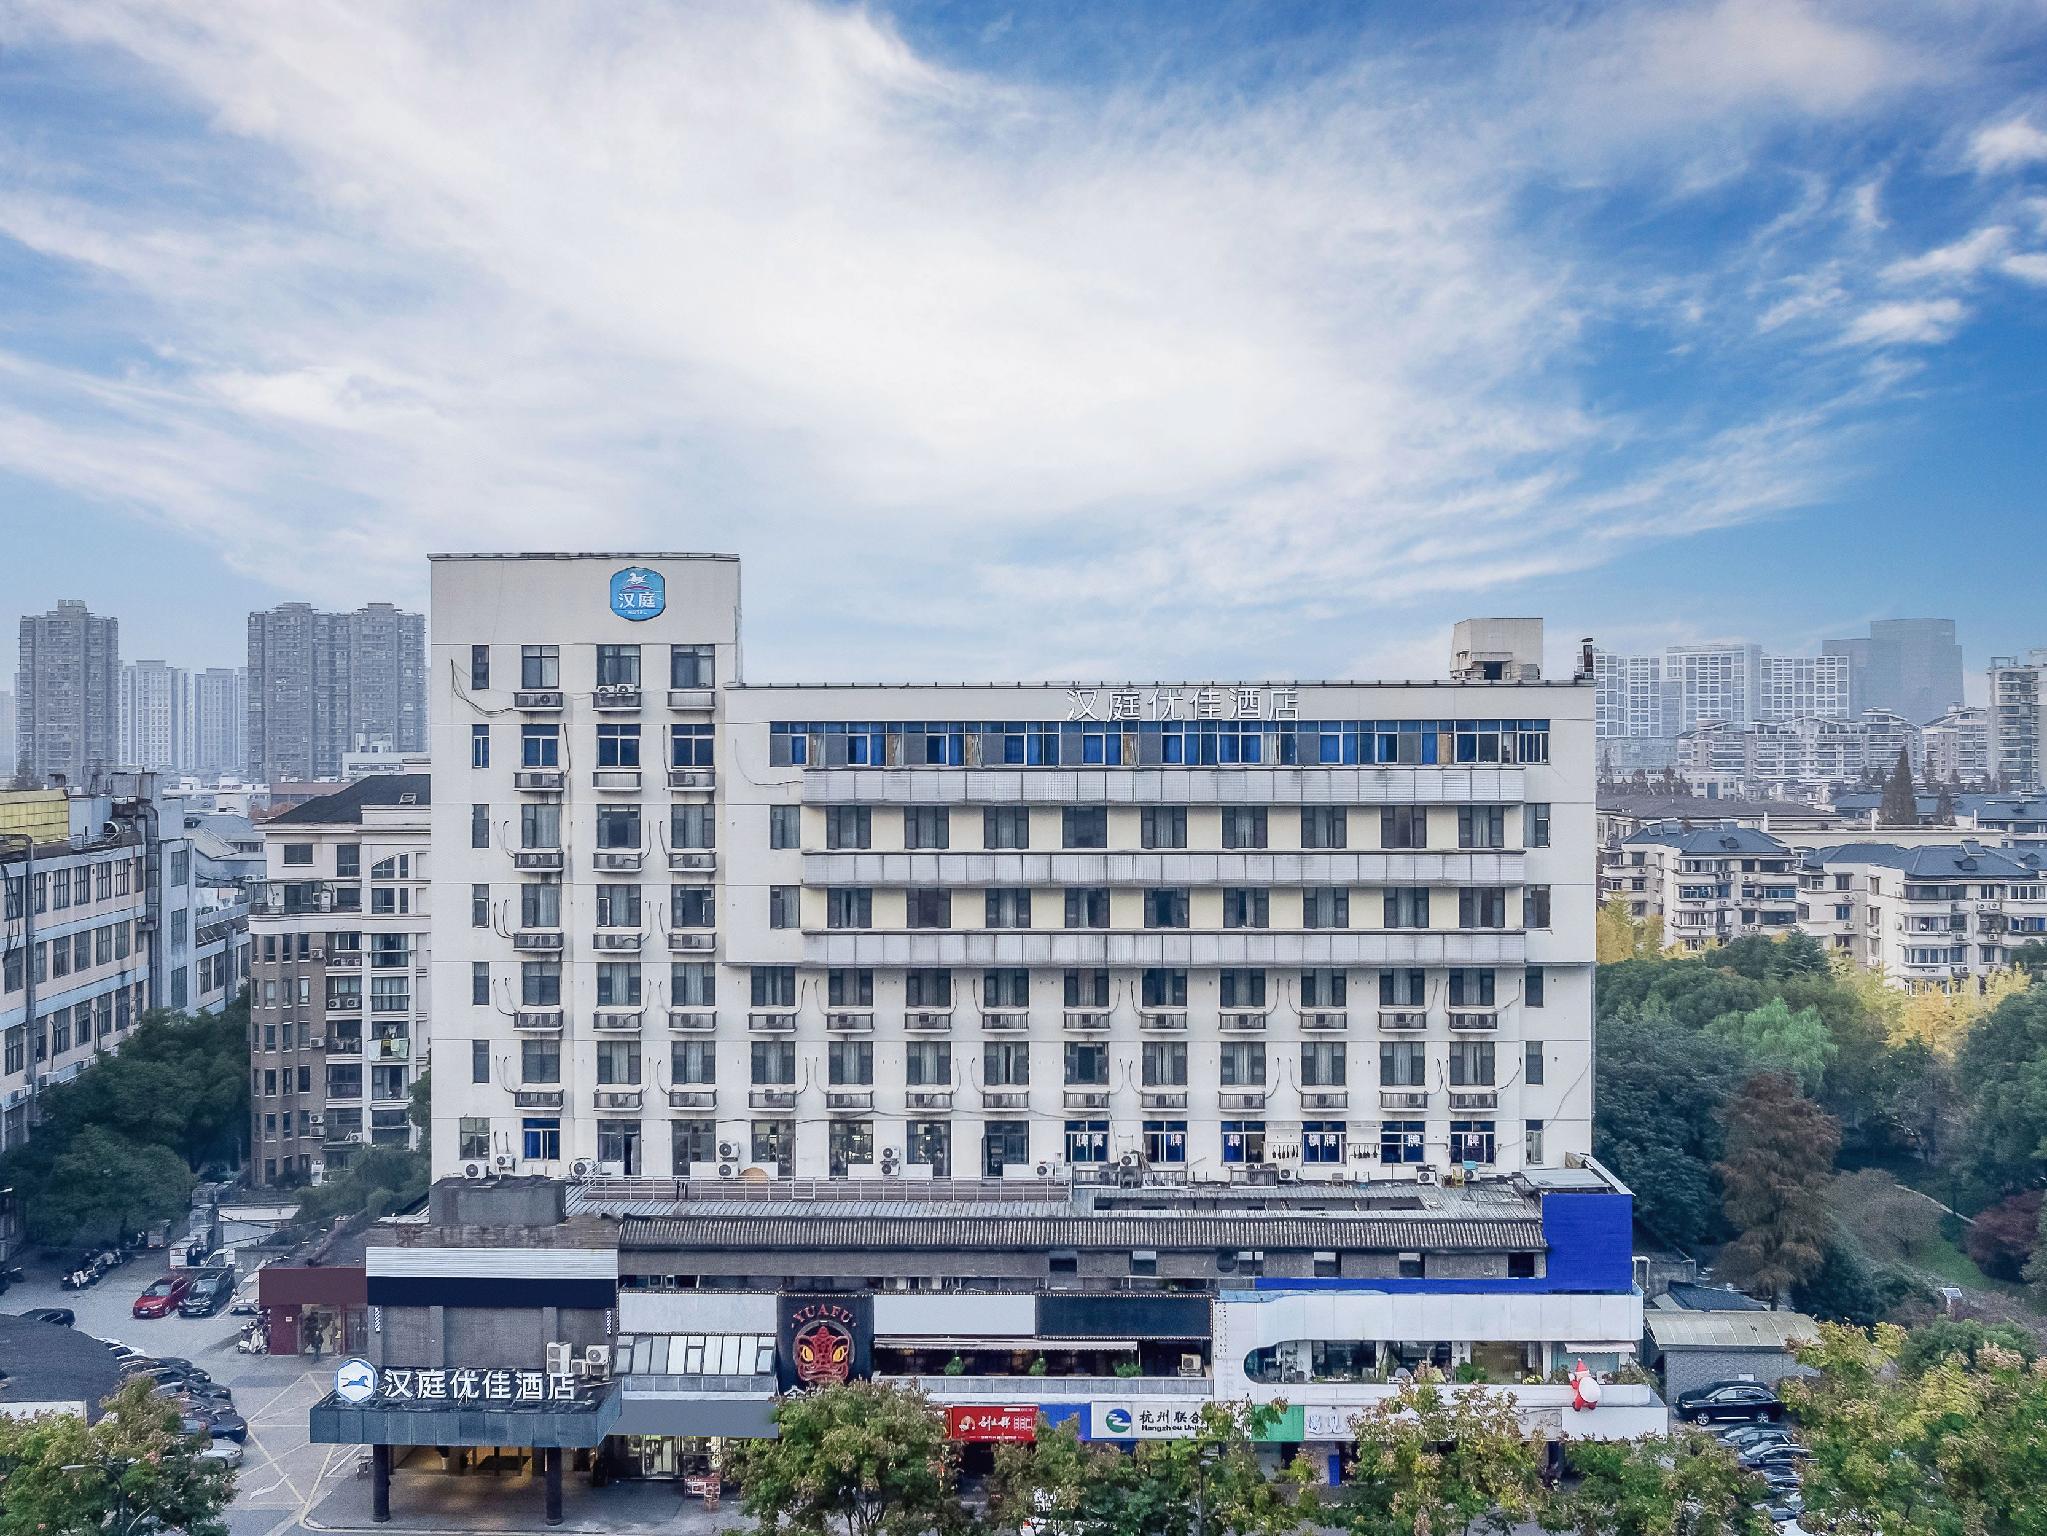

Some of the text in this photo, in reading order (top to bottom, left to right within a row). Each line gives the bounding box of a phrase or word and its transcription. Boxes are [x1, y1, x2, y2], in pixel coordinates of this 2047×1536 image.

[618, 592, 656, 609] 汉庭
[1066, 688, 1300, 721] 汉庭优佳酒店
[793, 1303, 853, 1323] YUAFU
[384, 1369, 576, 1400] 汉庭优佳酒店
[1139, 1409, 1202, 1425] 杭州联合
[1141, 1424, 1182, 1432] Hangzhou
